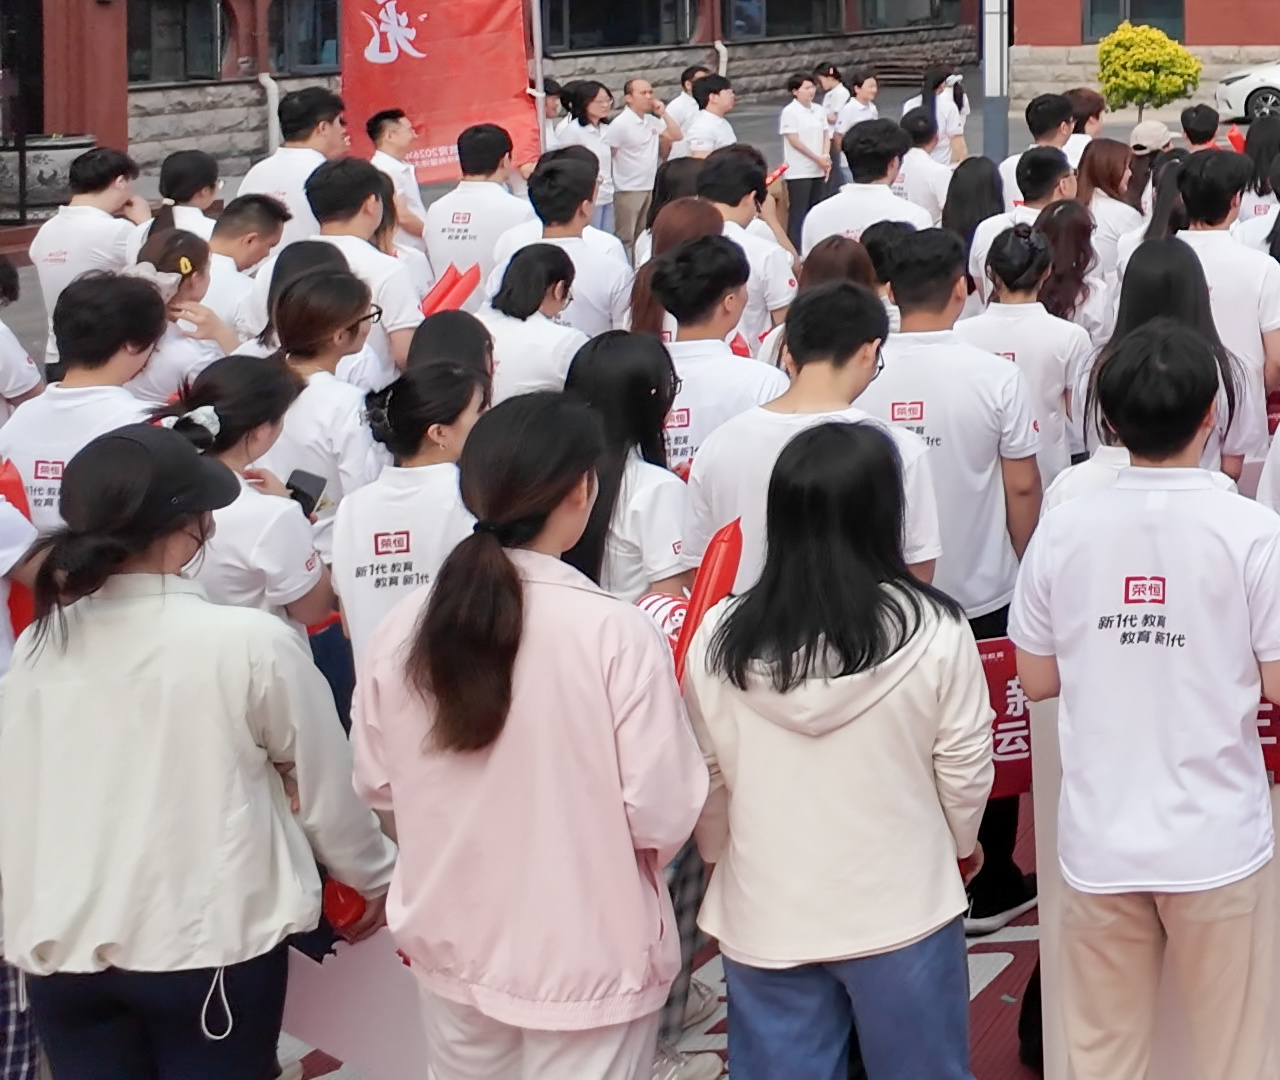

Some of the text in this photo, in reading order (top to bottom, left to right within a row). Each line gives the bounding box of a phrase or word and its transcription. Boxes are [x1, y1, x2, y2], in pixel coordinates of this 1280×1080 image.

[1132, 583, 1162, 596] 荣恒
[1098, 613, 1166, 629] 新1代 教育
[1120, 630, 1186, 647] 教育 新1代
